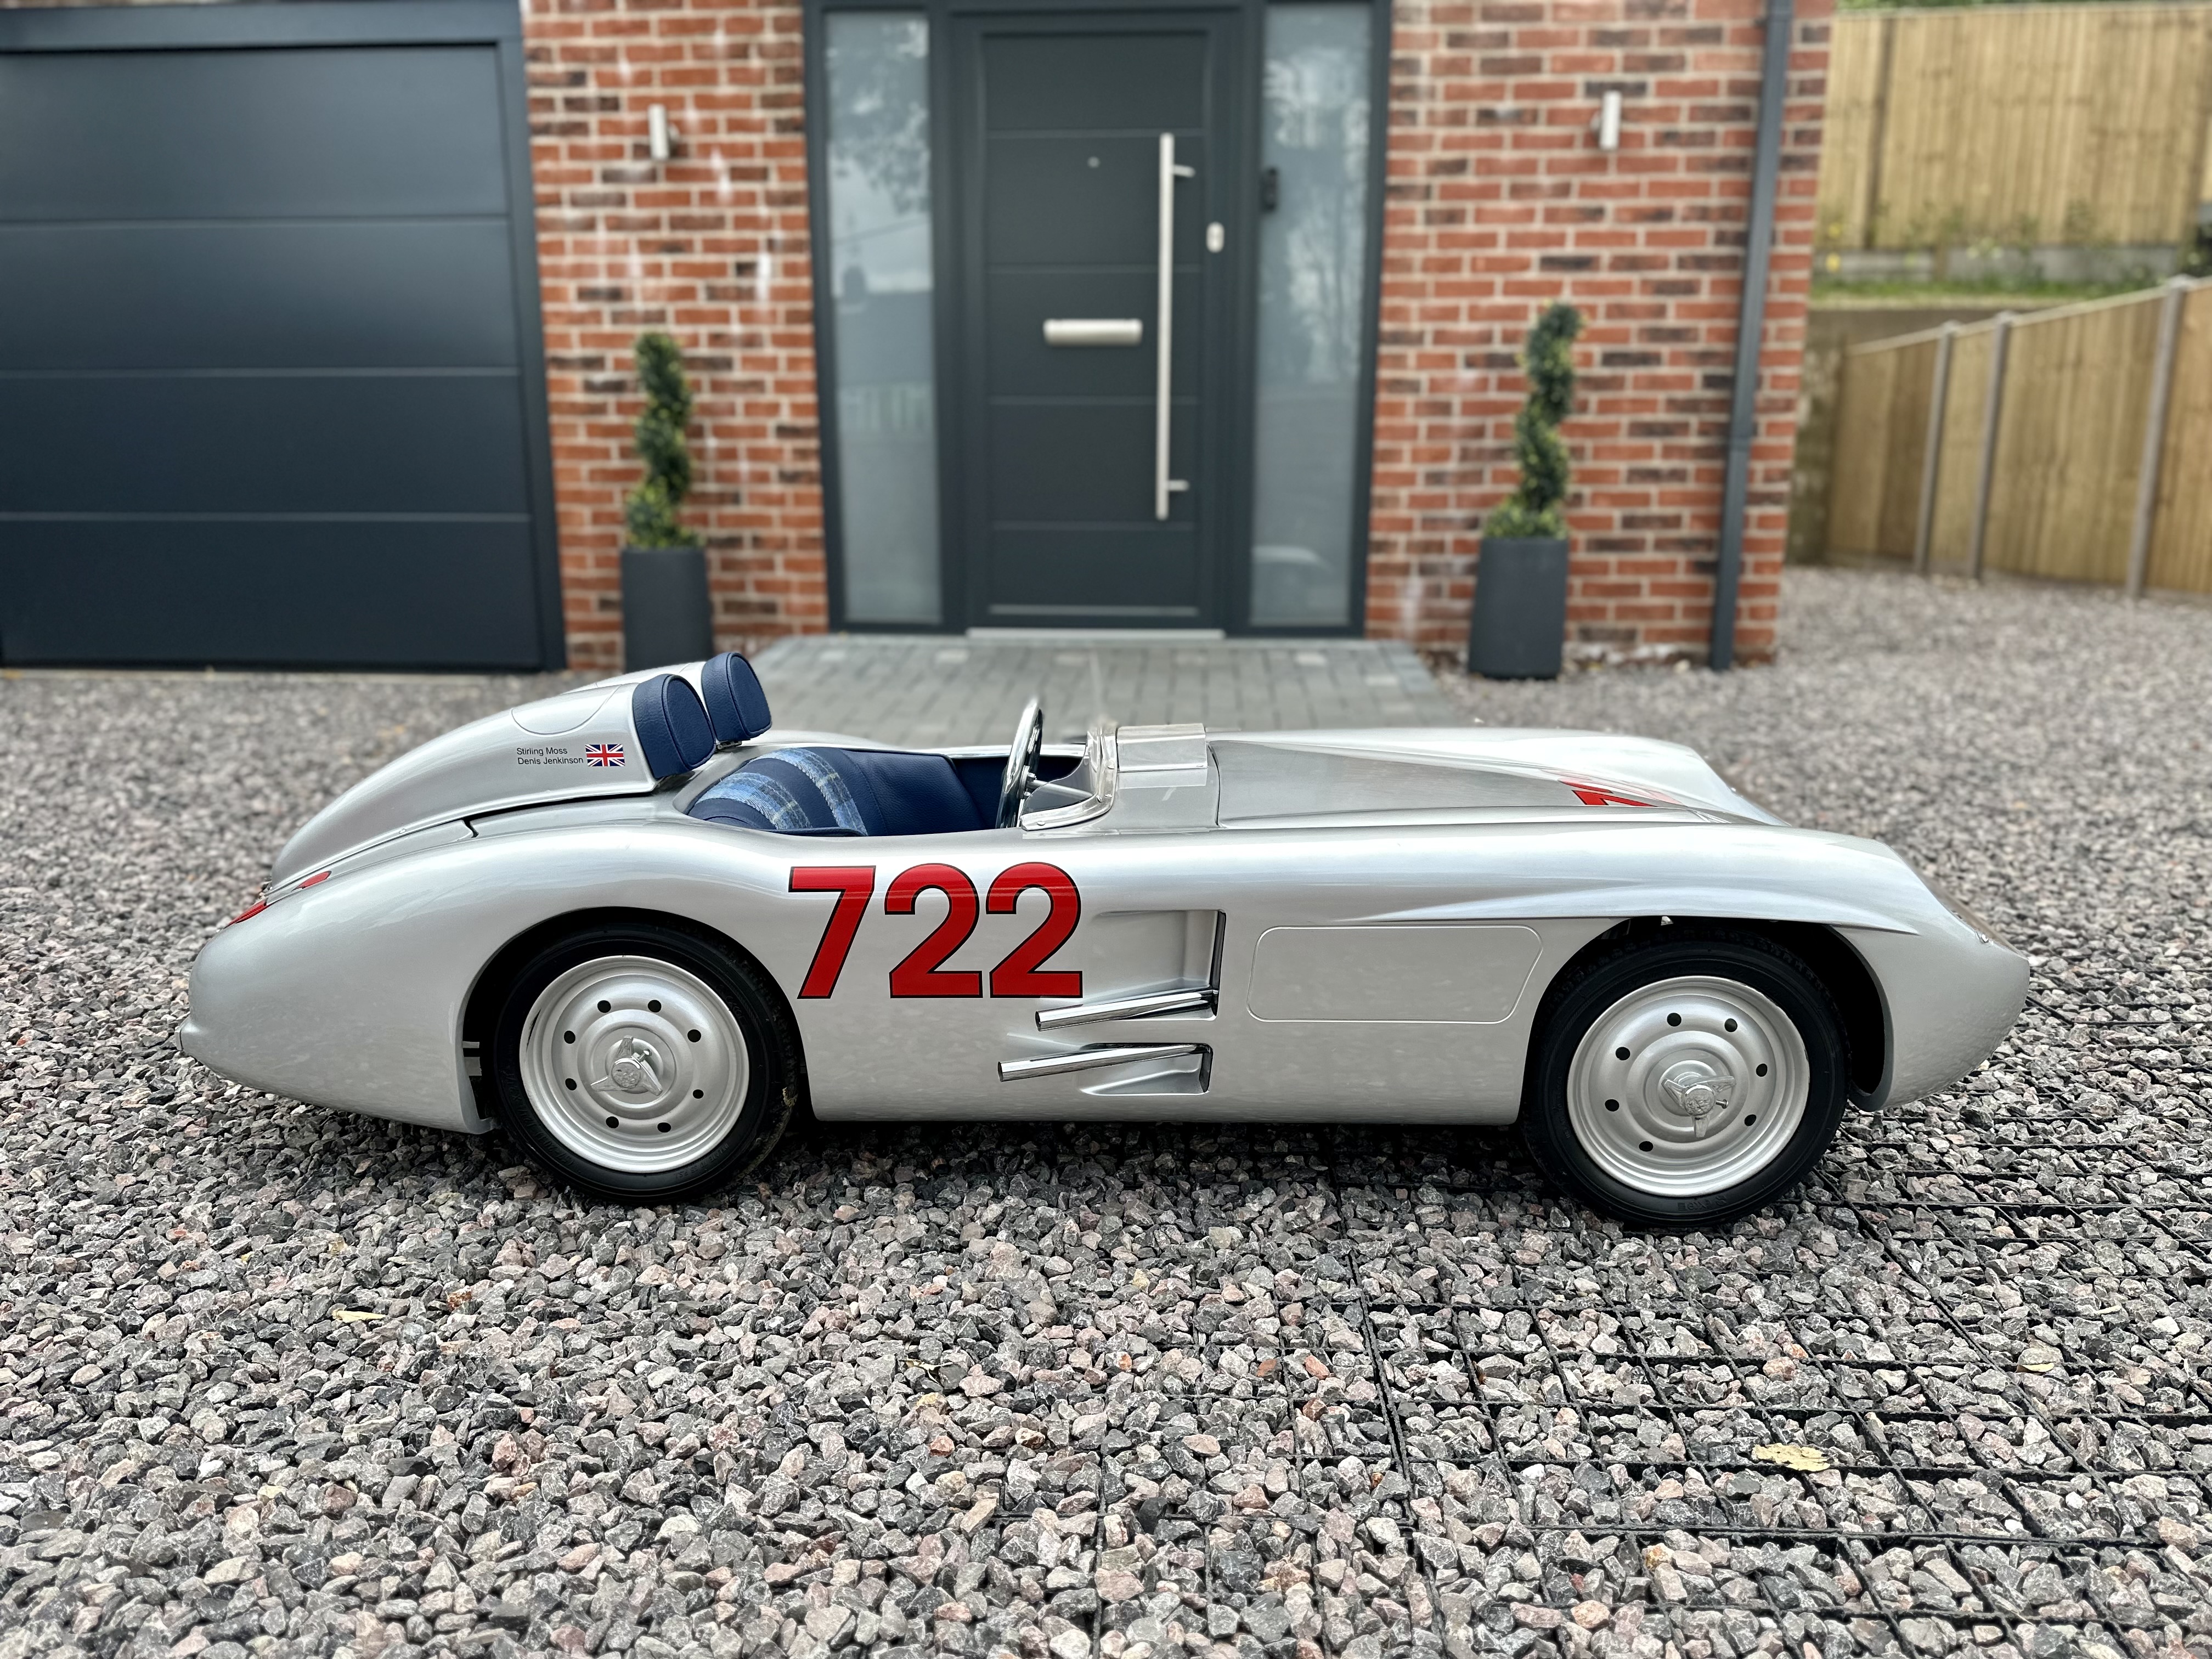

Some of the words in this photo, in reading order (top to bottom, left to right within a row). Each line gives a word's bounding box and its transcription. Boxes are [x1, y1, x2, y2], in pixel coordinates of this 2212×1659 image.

[516, 747, 544, 757] Stirling
[546, 747, 568, 755] Moss
[788, 862, 1084, 999] 722
